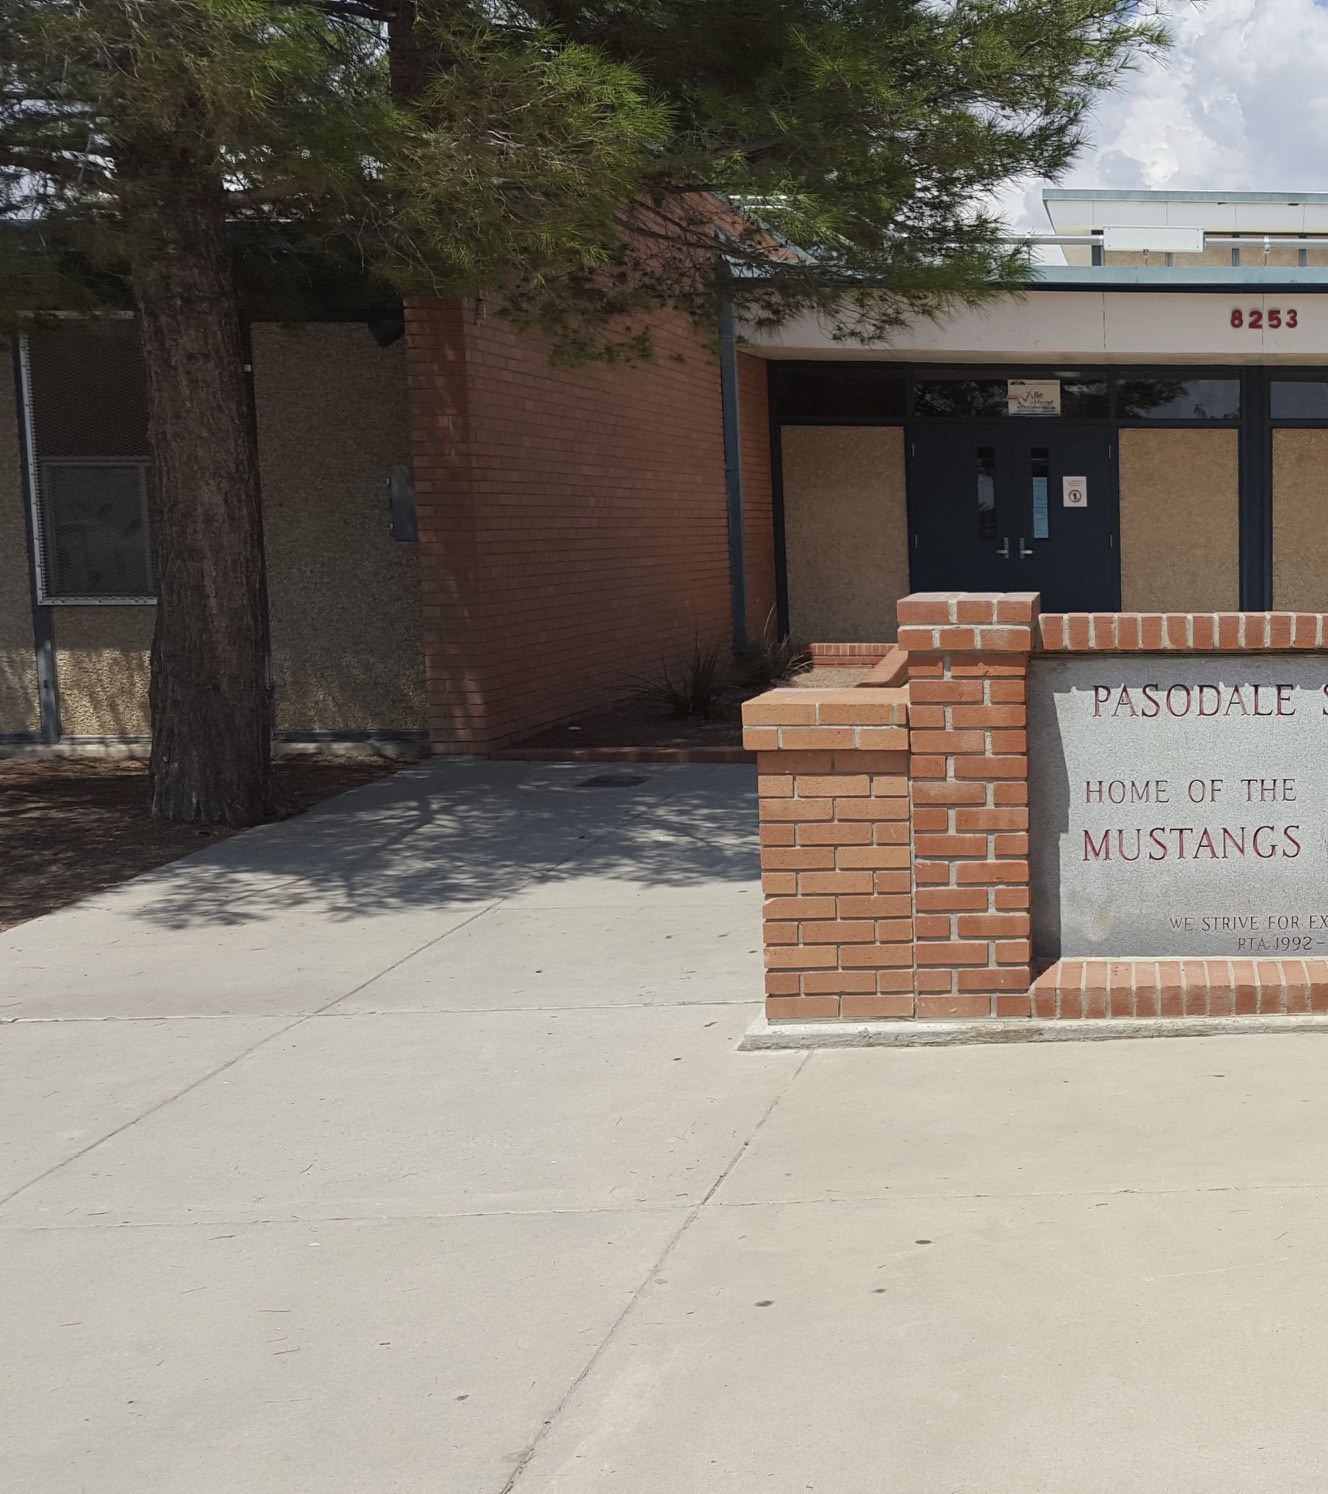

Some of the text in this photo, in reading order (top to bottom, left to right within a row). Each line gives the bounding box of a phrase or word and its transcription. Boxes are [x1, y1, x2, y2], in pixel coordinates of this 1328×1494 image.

[1230, 309, 1298, 329] 8253
[1034, 391, 1044, 399] Be
[1092, 682, 1297, 718] PASODALE
[1084, 778, 1297, 804] HOME OF THE
[1082, 824, 1301, 861] MUSTANGS
[1169, 917, 1194, 931] WE
[1201, 916, 1260, 931] STRIVE
[1267, 915, 1300, 930] FOR
[1237, 937, 1269, 951] PTA
